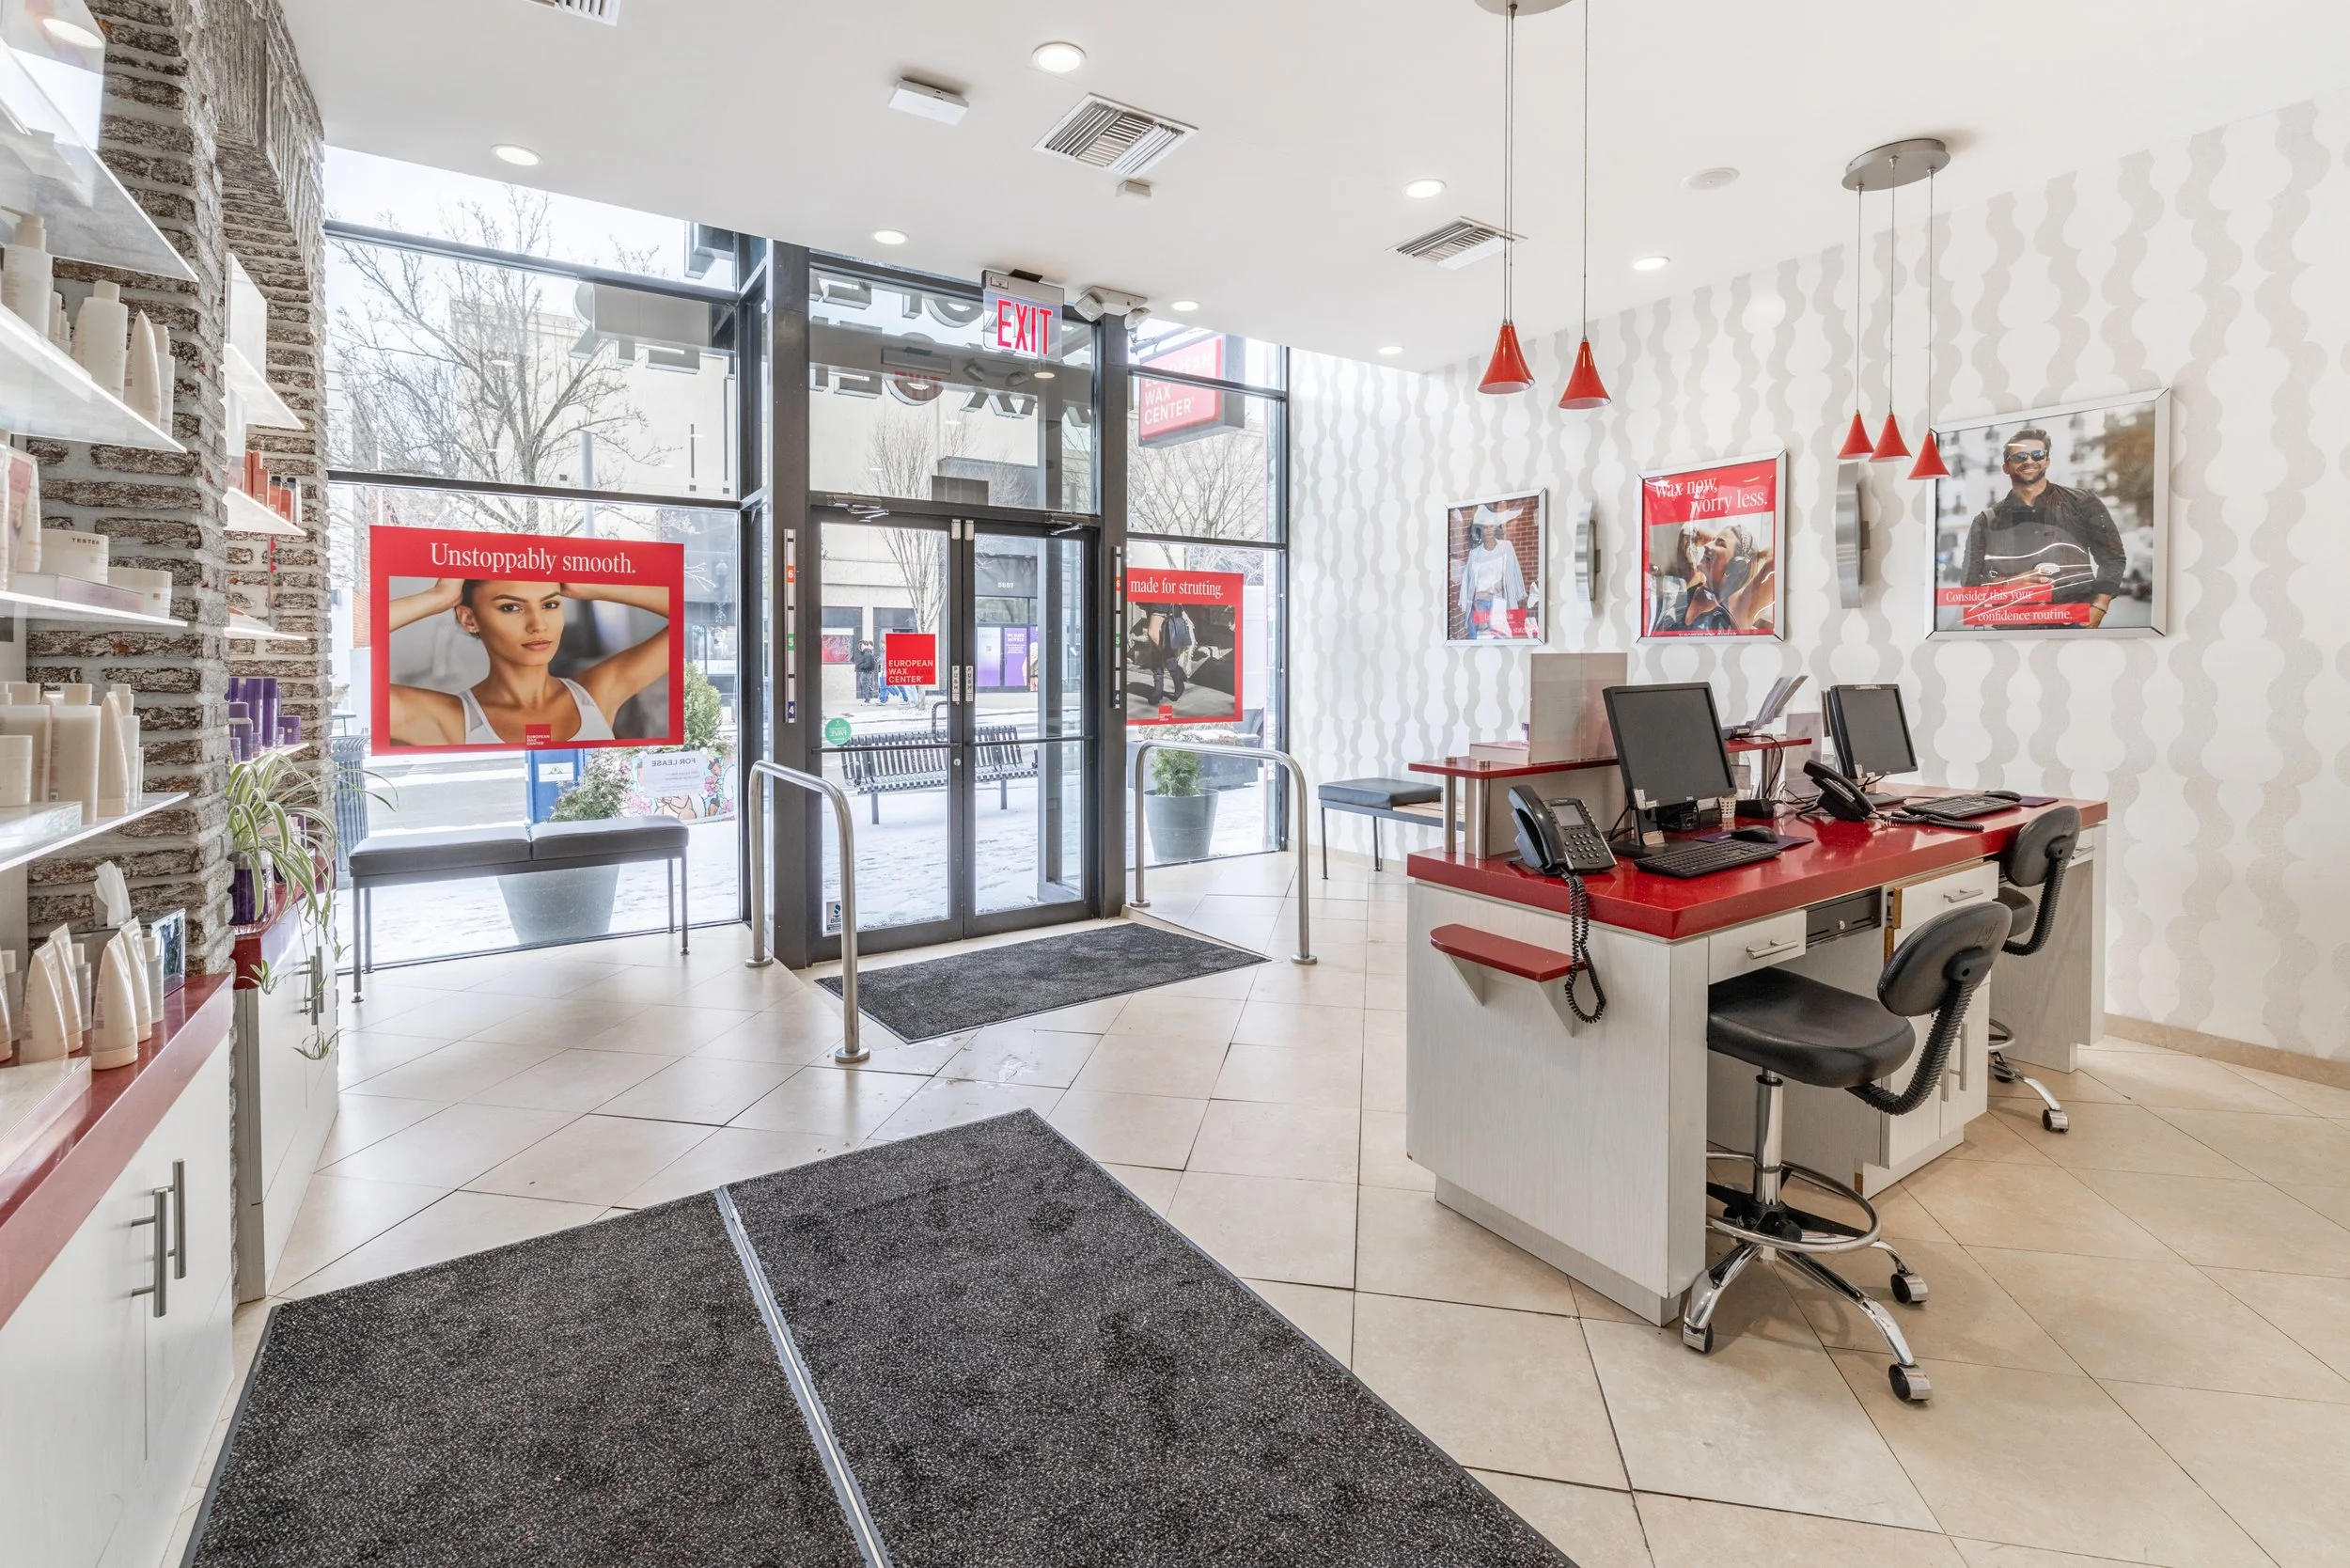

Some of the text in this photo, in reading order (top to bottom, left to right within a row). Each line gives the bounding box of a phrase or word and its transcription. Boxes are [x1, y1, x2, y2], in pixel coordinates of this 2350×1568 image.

[997, 298, 1053, 355] EXIT
[1144, 384, 1171, 406] WAX
[1144, 398, 1192, 425] CENTER
[1687, 478, 1718, 495] now,
[1690, 489, 1768, 514] worry less.
[431, 542, 636, 574] Unstoppably smooth.
[788, 570, 793, 578] 6
[1130, 577, 1224, 599] made for strutting.
[1946, 589, 2033, 602] Consider this your
[1978, 609, 2073, 621] confidence routine.
[789, 637, 794, 647] 5
[789, 705, 794, 714] 4
